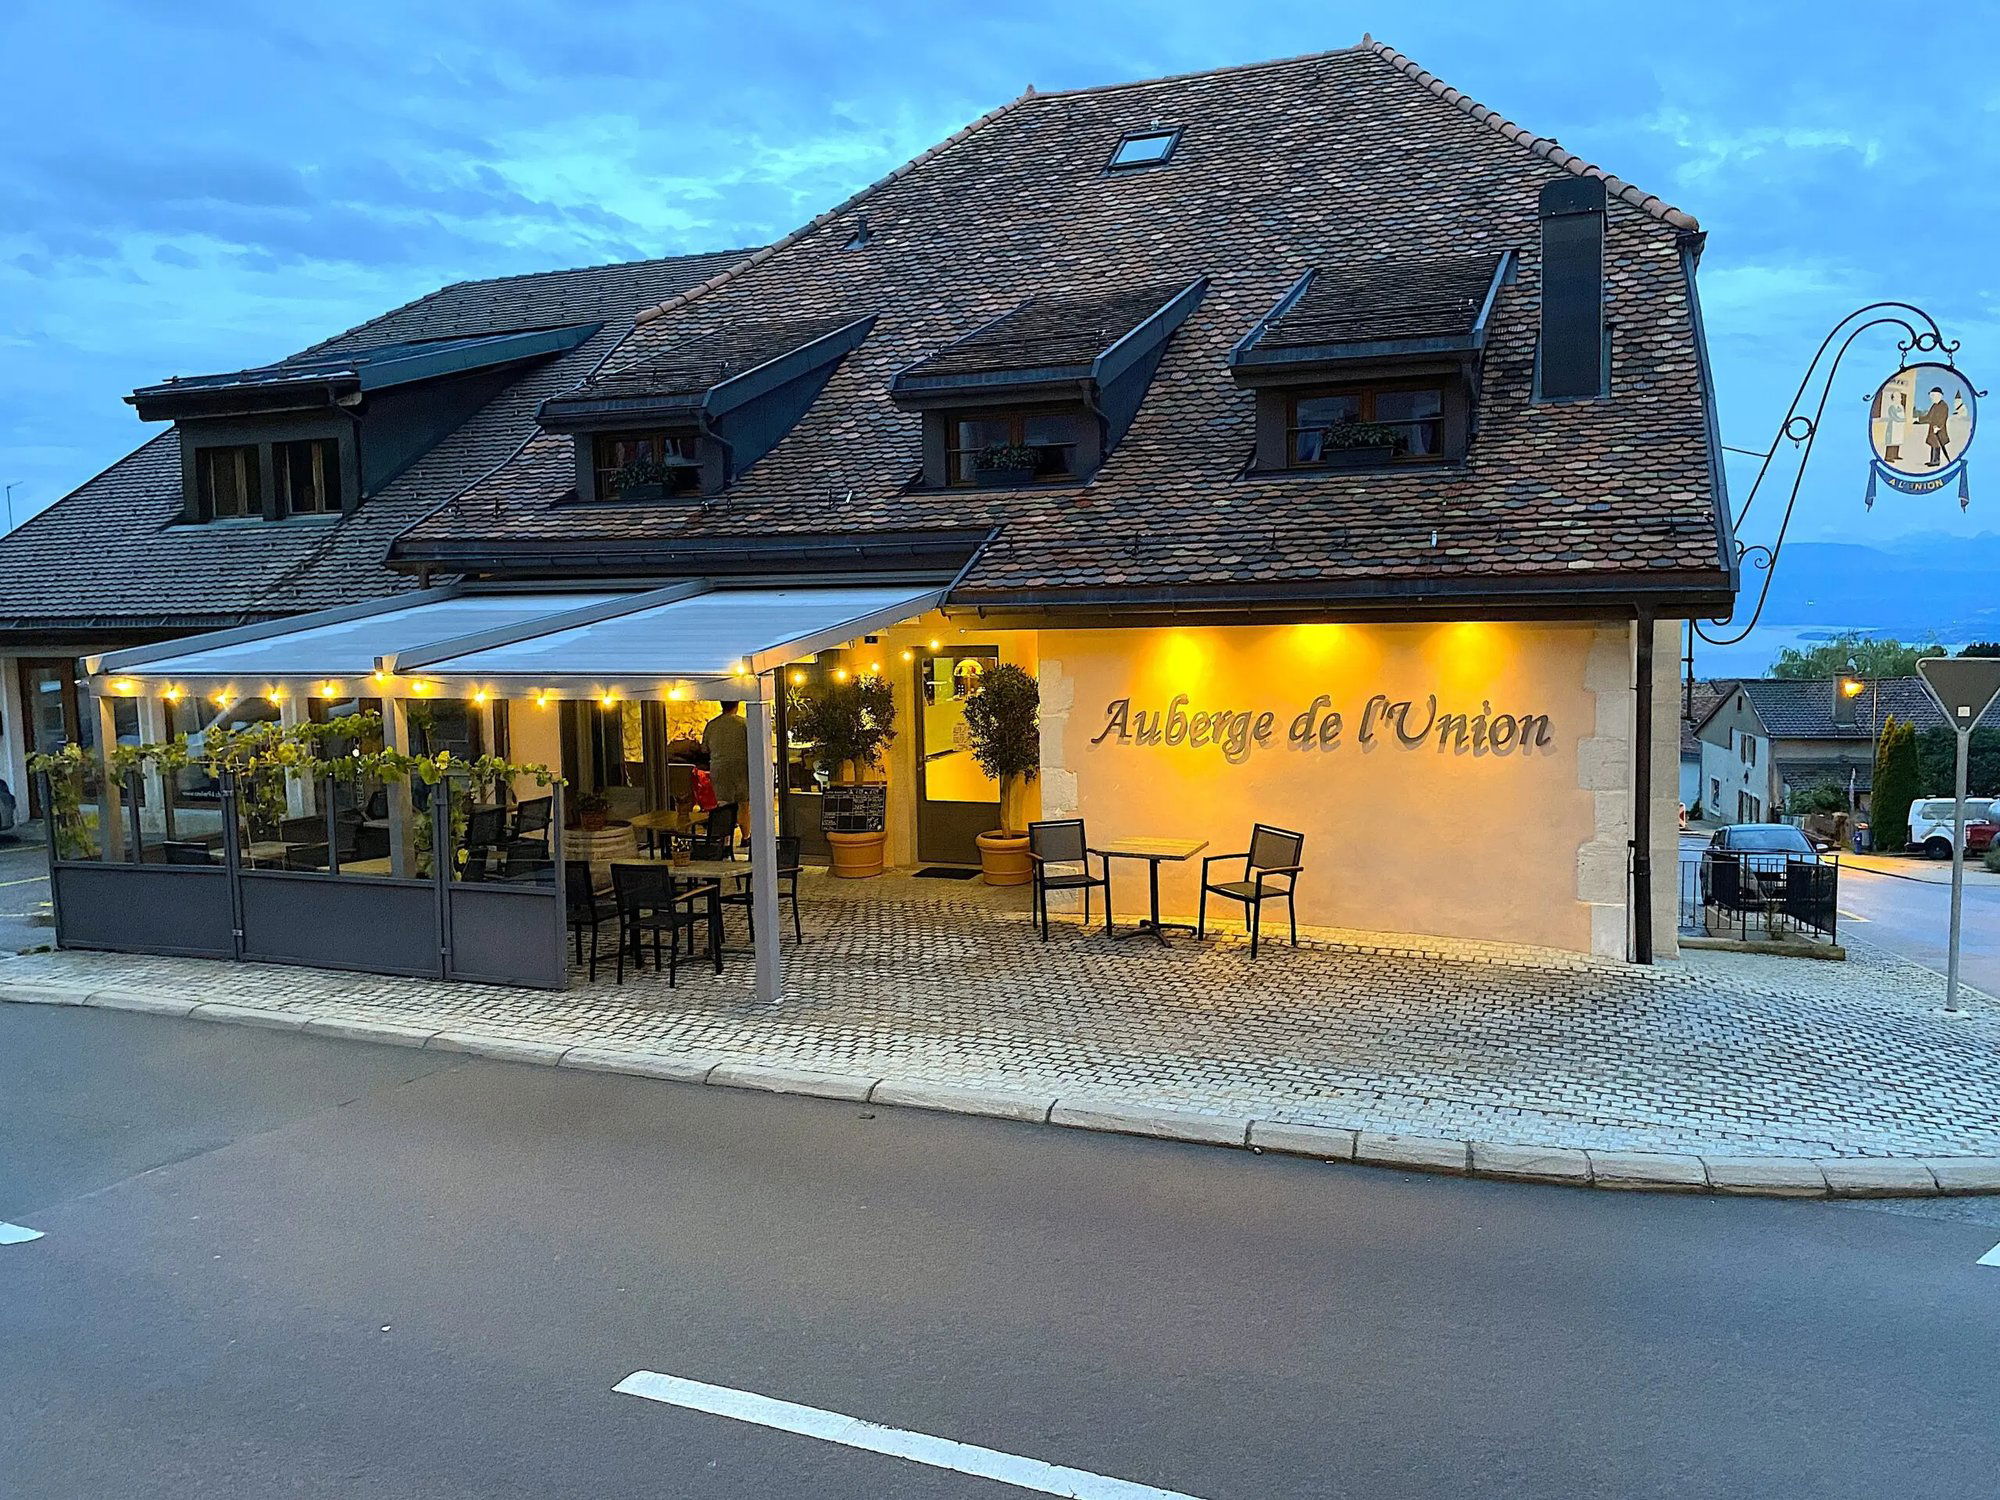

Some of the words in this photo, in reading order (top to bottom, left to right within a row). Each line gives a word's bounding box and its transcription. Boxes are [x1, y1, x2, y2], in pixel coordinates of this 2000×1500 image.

[1090, 694, 1275, 762] Auberge
[1288, 695, 1341, 747] de
[1358, 694, 1552, 752] l'Union
